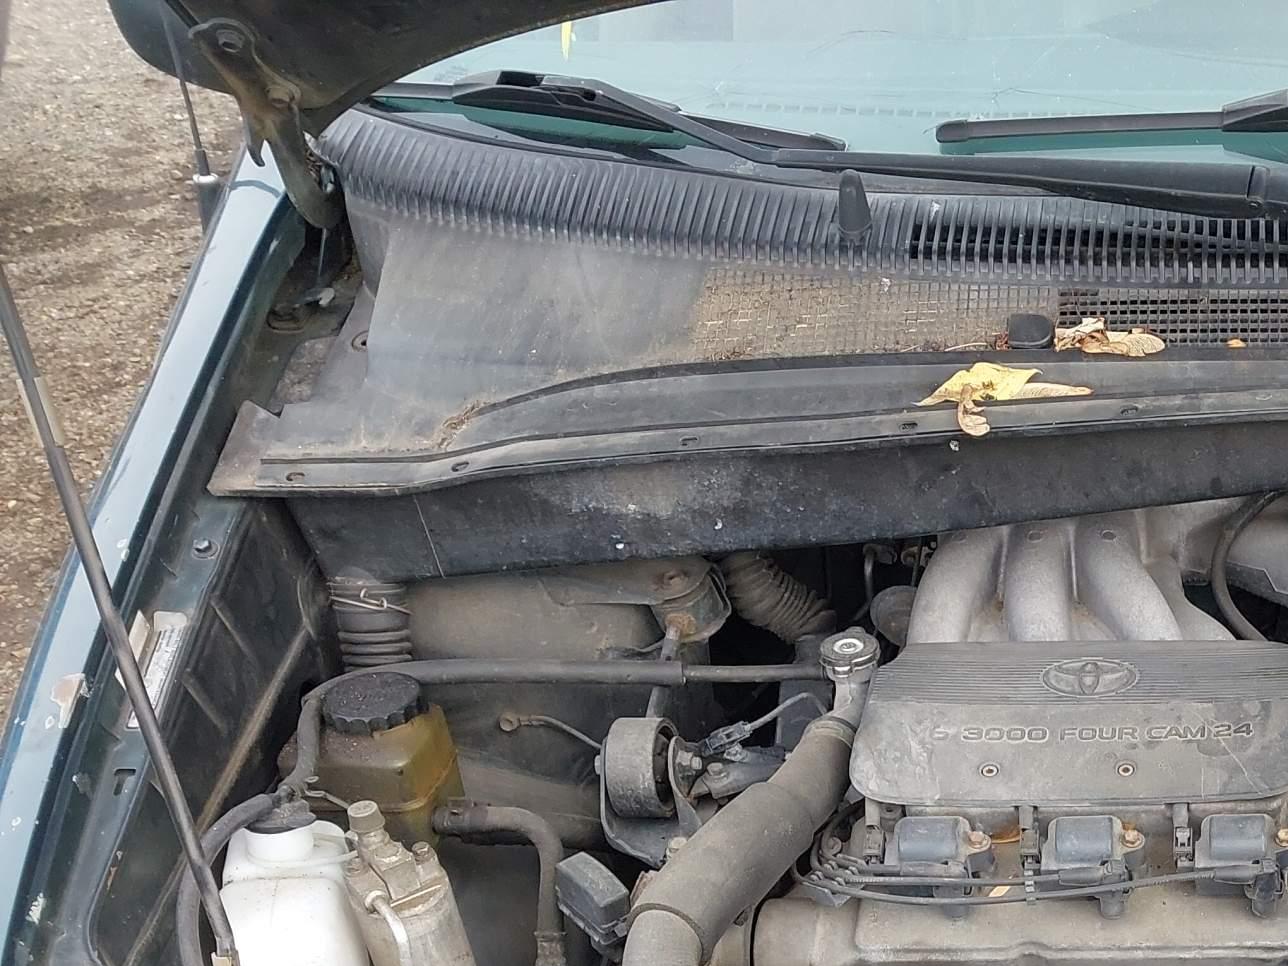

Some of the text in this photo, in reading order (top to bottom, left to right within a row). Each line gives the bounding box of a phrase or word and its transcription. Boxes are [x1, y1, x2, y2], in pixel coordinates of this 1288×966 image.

[961, 726, 1049, 742] 3000
[1059, 726, 1139, 742] FOUR
[1146, 724, 1206, 740] CAM
[1213, 722, 1254, 738] 24
